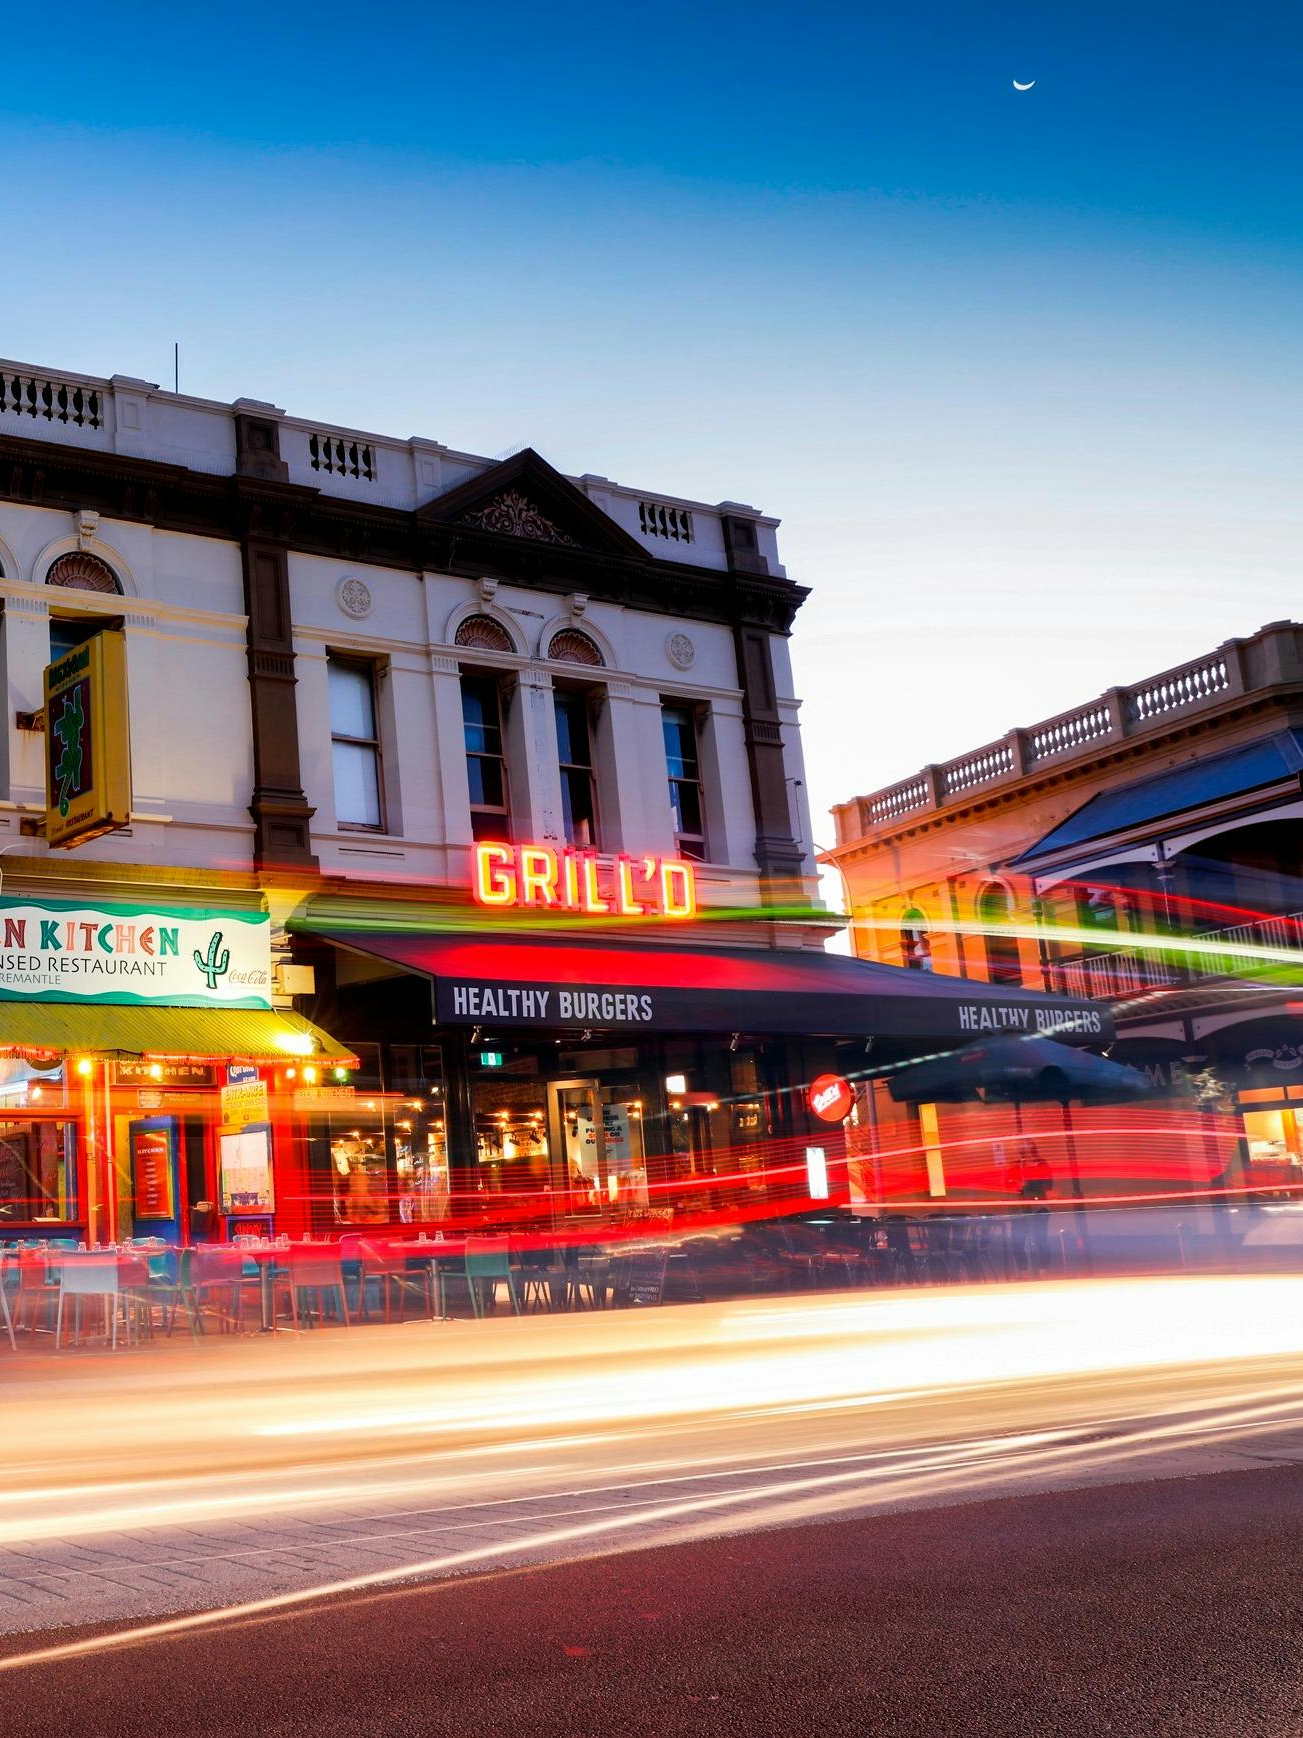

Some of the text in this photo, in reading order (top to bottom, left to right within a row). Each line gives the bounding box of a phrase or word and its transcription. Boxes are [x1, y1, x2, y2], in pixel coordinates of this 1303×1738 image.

[40, 919, 179, 956] KITCHEN
[48, 956, 167, 976] RESTAURANT
[453, 987, 653, 1021] HEALTHY BURGERS
[958, 1006, 1102, 1033] HEALTHY BURGERS
